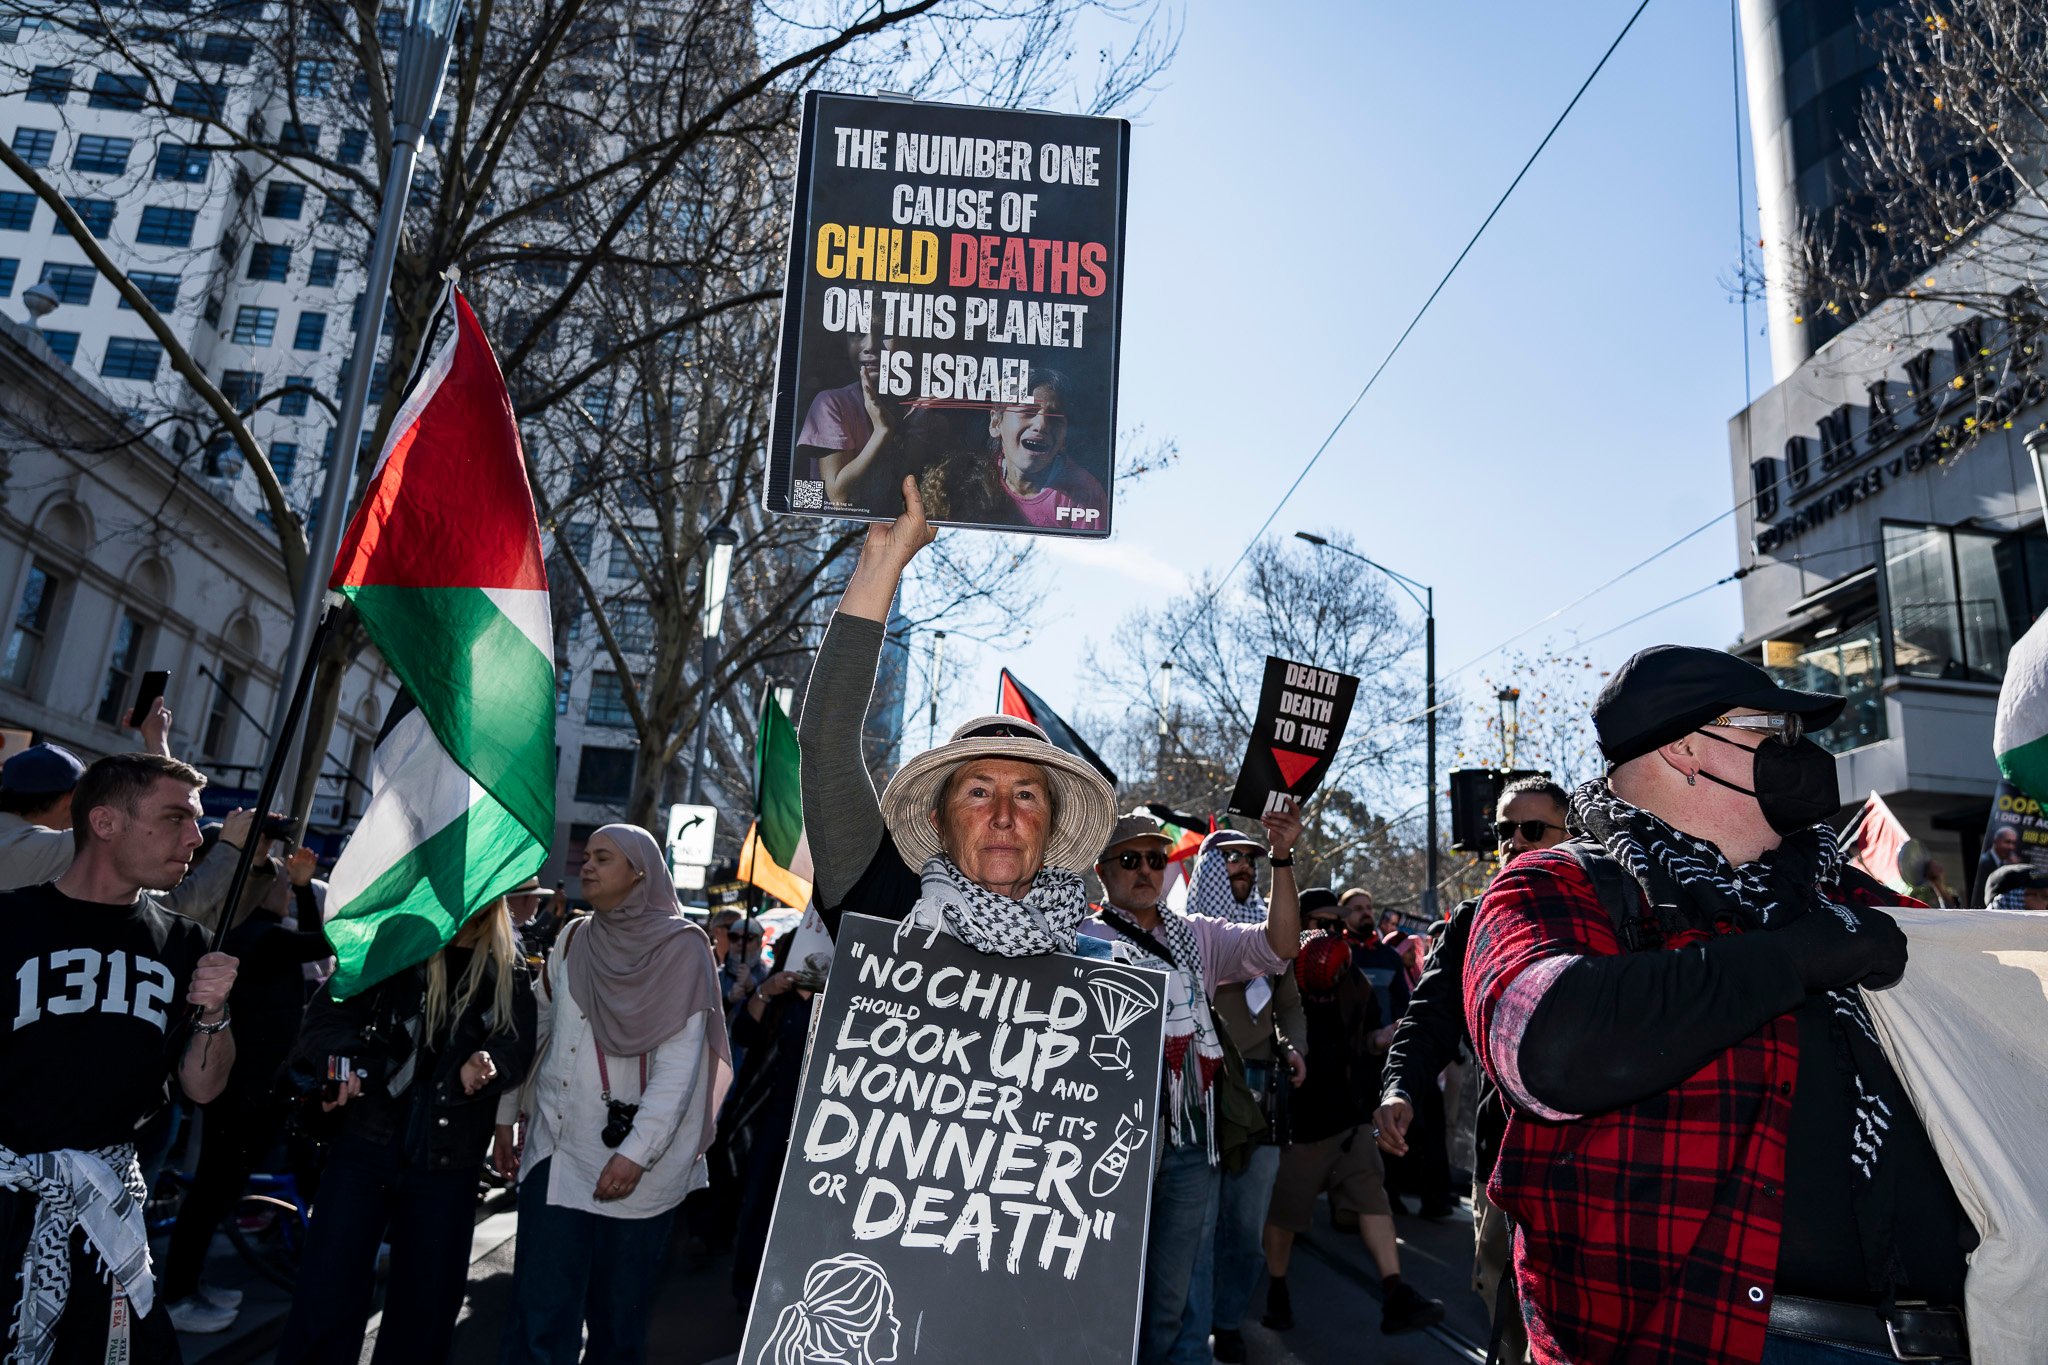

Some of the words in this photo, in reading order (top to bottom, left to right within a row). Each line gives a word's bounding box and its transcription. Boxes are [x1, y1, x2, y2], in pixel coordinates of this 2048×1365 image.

[834, 126, 888, 171] THE
[894, 132, 1033, 183] NUMBER
[1040, 142, 1101, 187] ONE
[892, 184, 992, 230] CAUSE
[999, 192, 1038, 233] OF
[815, 222, 939, 285] CHILD
[948, 233, 1107, 297] DEATHS
[822, 287, 874, 335] ON
[882, 291, 957, 341] THIS
[963, 296, 1089, 348] PLANET
[878, 349, 913, 396] IS
[920, 353, 1036, 405] ISRAEL
[1056, 507, 1101, 523] FPP
[1284, 663, 1340, 696] DEATH
[1279, 690, 1334, 723] DEATH
[1273, 717, 1296, 743] TO
[1300, 723, 1330, 750] THE
[1998, 795, 2044, 817] OOP
[2000, 812, 2021, 824] DID
[2022, 815, 2034, 826] IT
[13, 947, 176, 1034] 1312
[849, 995, 921, 1020] SHOULD
[926, 966, 1089, 1031] CHILD
[835, 1009, 982, 1074] LOOK
[988, 1022, 1079, 1093] UP
[1051, 1078, 1099, 1103] AND
[819, 1052, 1024, 1134] WONDER
[1031, 1111, 1054, 1135] IF
[1057, 1114, 1098, 1141] IT'S
[803, 1098, 1085, 1219] DINNER
[808, 1171, 849, 1204] OR
